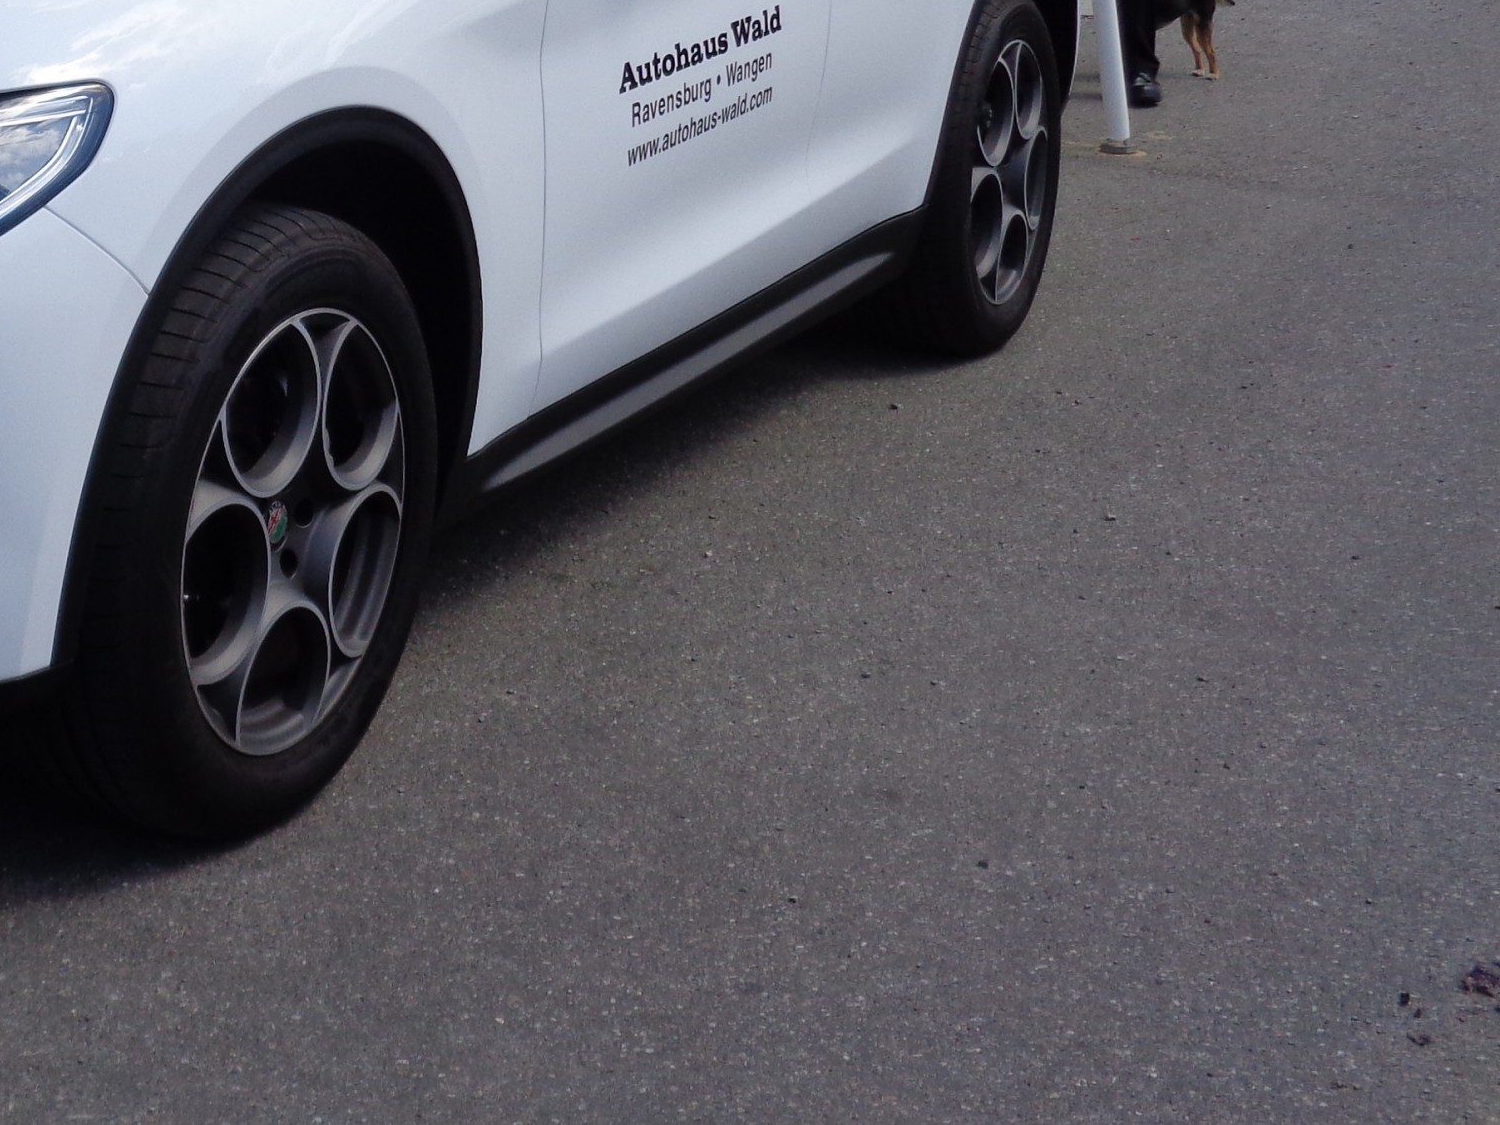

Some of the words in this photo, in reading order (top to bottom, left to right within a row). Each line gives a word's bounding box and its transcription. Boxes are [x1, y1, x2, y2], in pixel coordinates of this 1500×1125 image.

[619, 31, 729, 95] Autohaus
[730, 5, 782, 48] Wald
[631, 77, 712, 127] Ravensburg
[726, 52, 772, 88] Wangen
[627, 86, 773, 167] www.autohaus-wald.com
